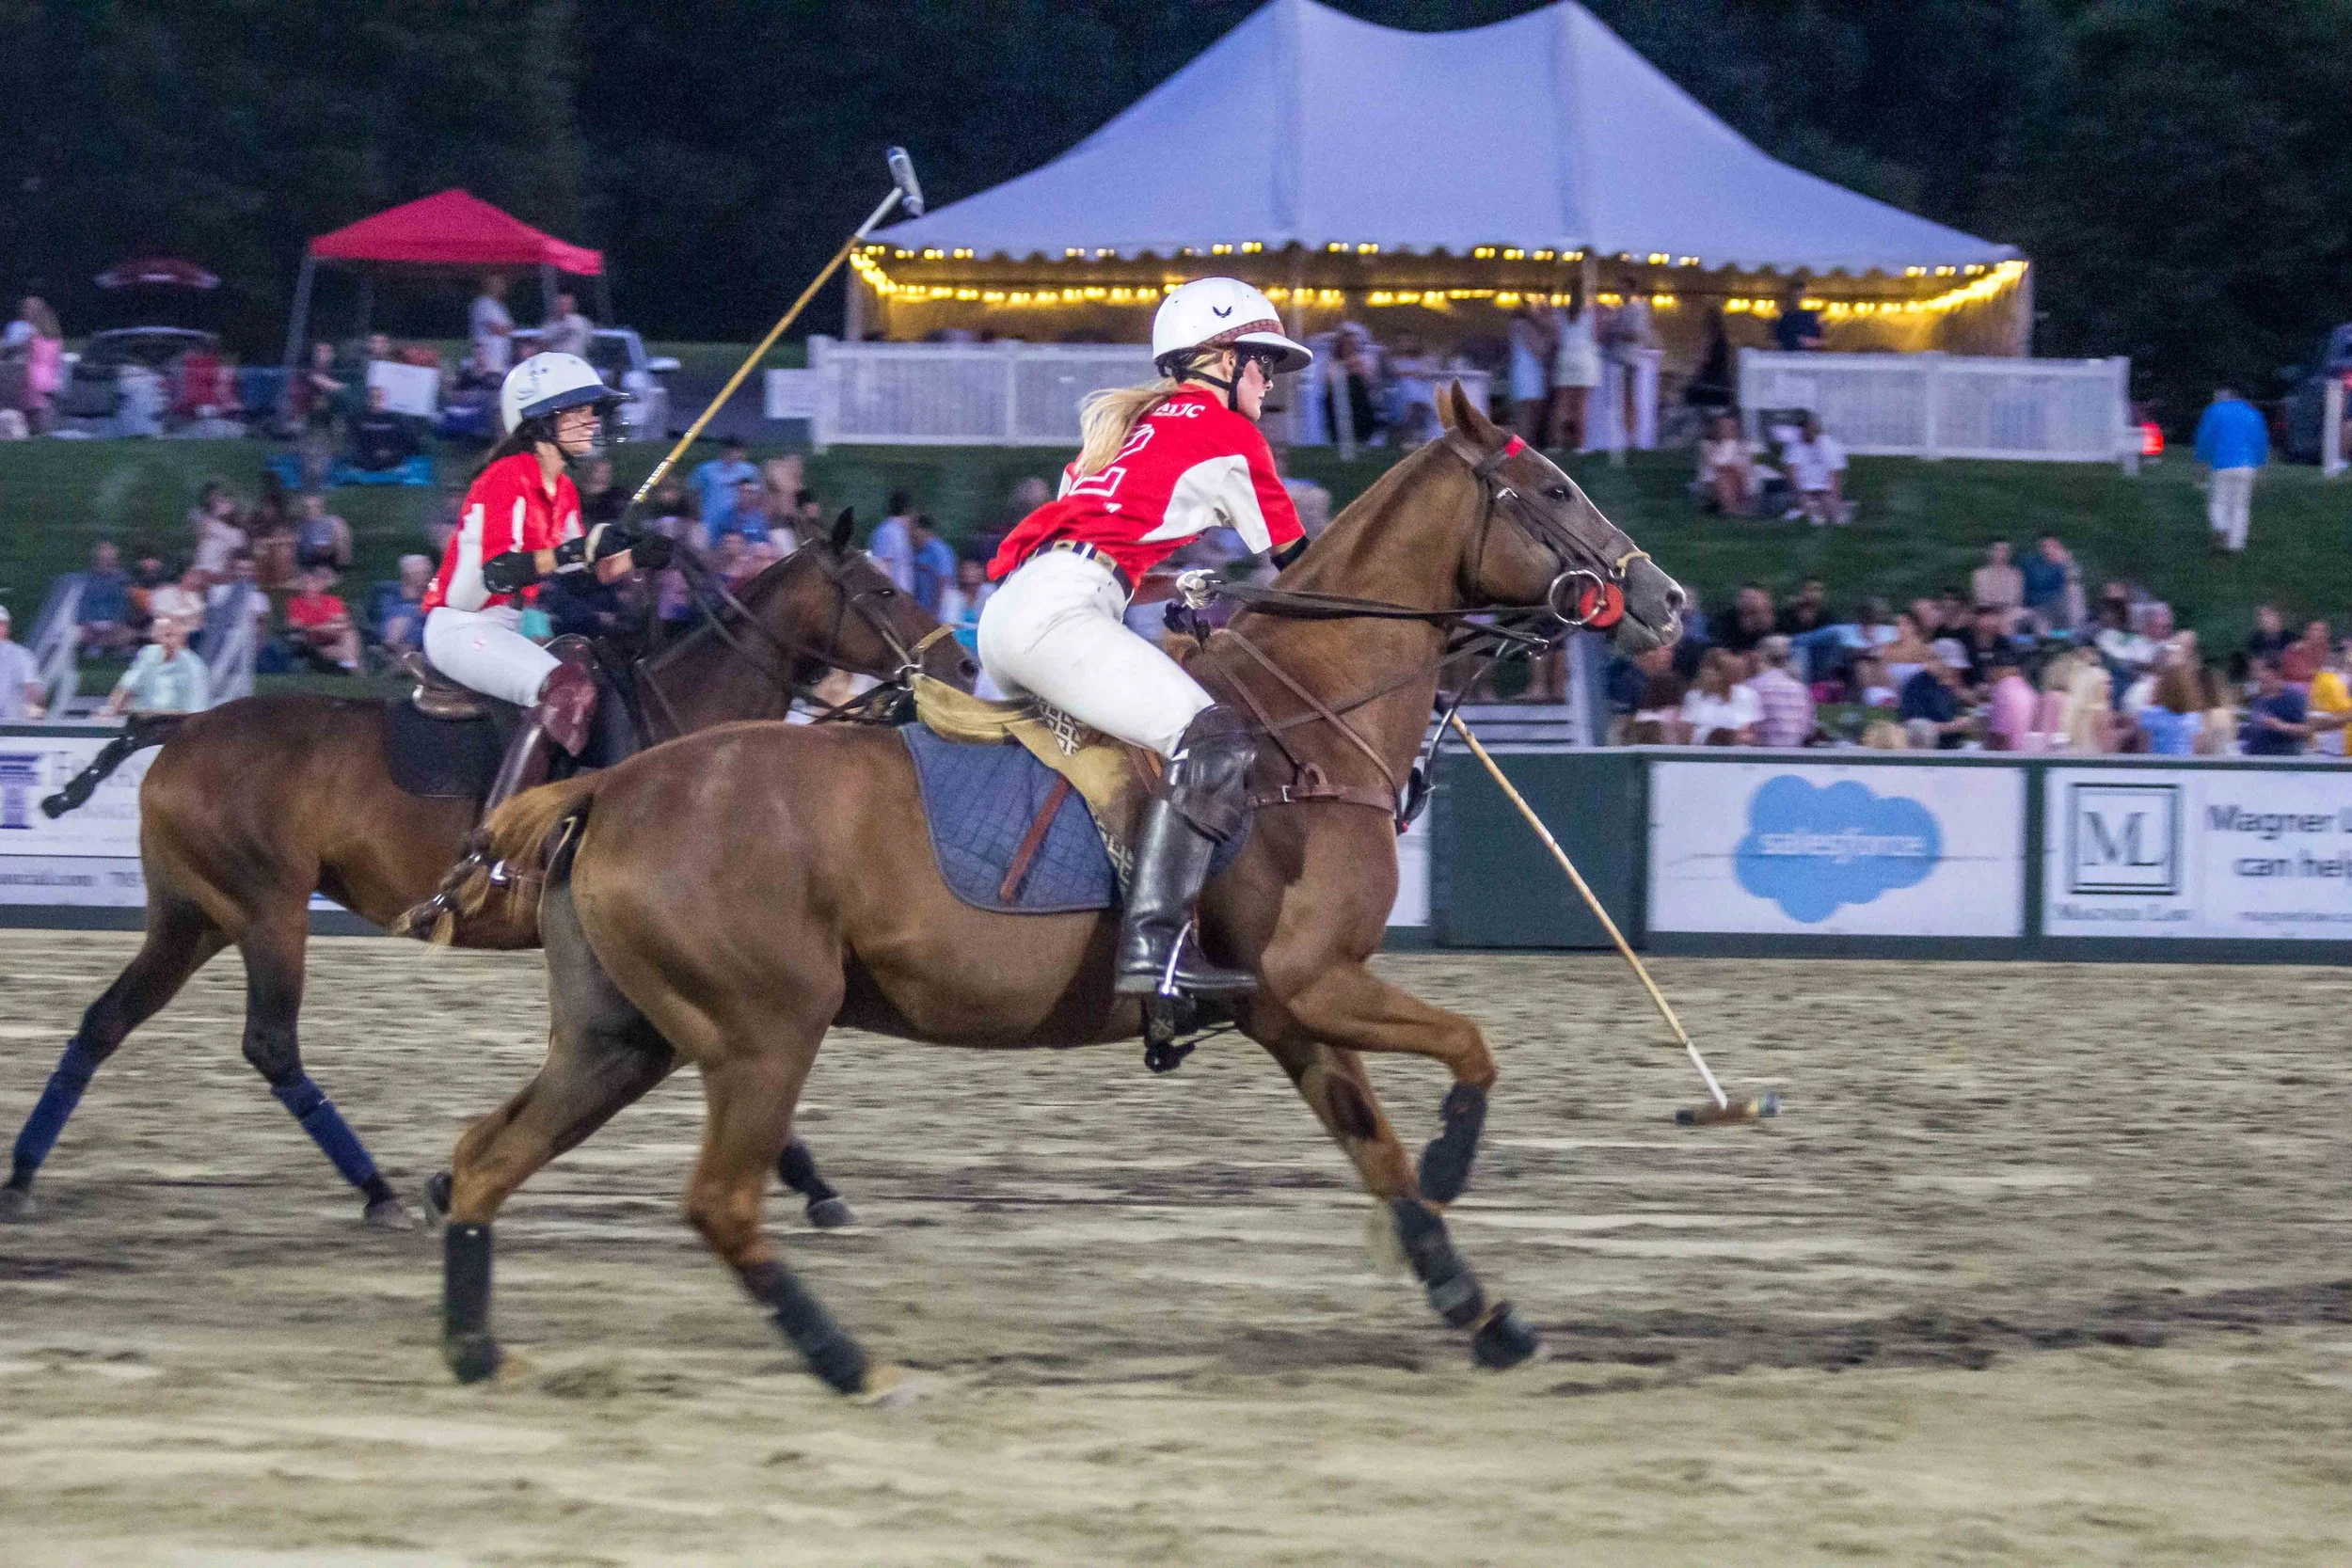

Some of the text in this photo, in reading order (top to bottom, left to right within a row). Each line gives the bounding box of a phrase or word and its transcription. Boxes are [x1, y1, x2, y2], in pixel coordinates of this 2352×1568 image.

[1067, 423, 1155, 498] 2
[2205, 804, 2335, 840] Magner
[2233, 858, 2289, 878] can
